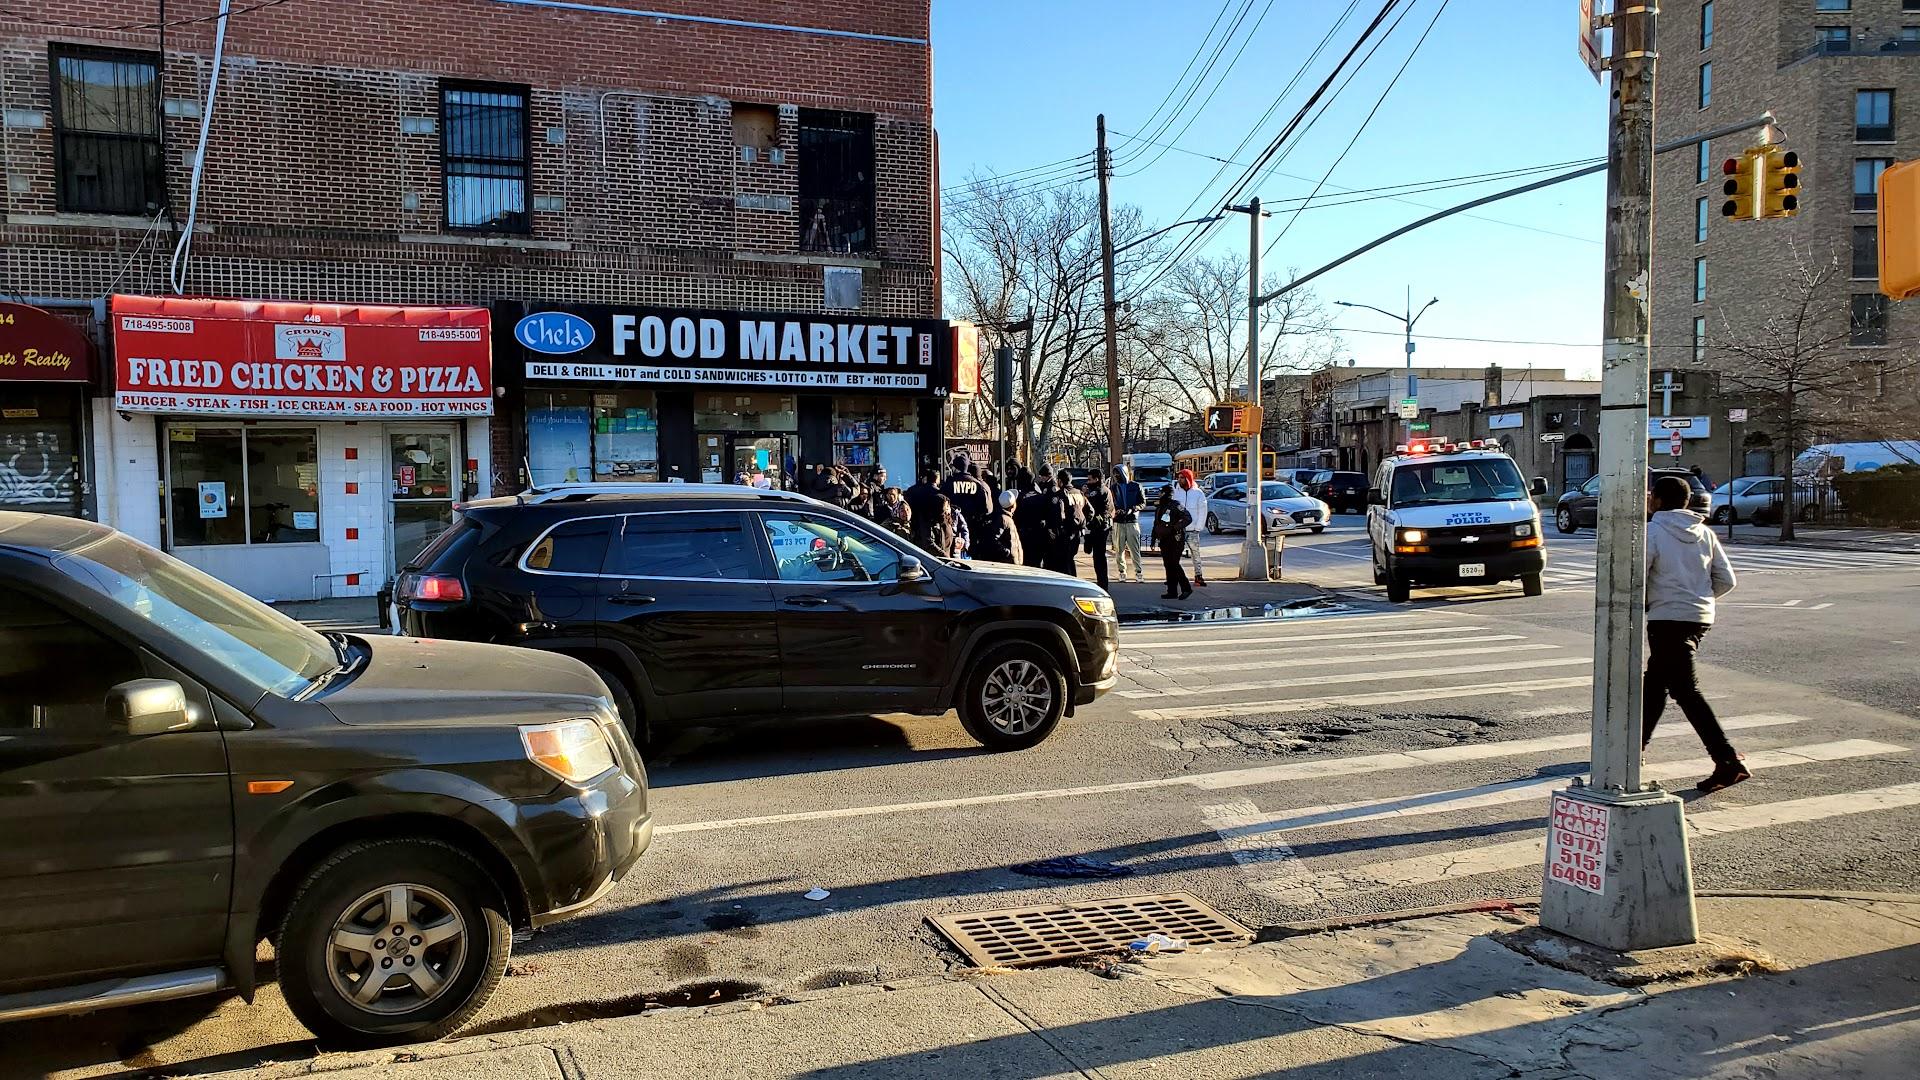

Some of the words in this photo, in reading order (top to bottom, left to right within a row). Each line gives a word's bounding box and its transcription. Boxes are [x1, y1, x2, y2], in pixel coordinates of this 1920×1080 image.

[124, 319, 192, 331] 718-495-5008
[285, 329, 331, 337] CROWN
[420, 329, 481, 340] 718-495-5001
[523, 317, 585, 347] Chela
[612, 314, 726, 359] FOOD
[739, 320, 913, 365] MARKET
[921, 335, 930, 364] CORP
[23, 348, 72, 371] Realty
[128, 357, 224, 388] FRIED
[230, 361, 365, 393] CHICKEN
[371, 365, 395, 393] &
[399, 365, 485, 393] PIZZA
[532, 365, 558, 377] DELI
[561, 366, 570, 377] &
[573, 366, 605, 378] GRILL
[614, 367, 637, 379] HOT
[640, 368, 660, 380] and
[663, 369, 692, 380] COLD
[694, 369, 767, 383] SANDWICHES
[774, 371, 808, 384] LOTTO
[816, 373, 839, 384] ATM
[846, 374, 865, 385] EBT
[873, 374, 892, 386] HOT
[894, 375, 920, 387] FOOD
[933, 386, 948, 397] 44
[121, 395, 177, 407] BURGER
[186, 398, 231, 409] STEAK
[239, 399, 269, 410] FISH
[278, 400, 299, 411] ICE
[301, 400, 346, 411] CREAM
[353, 401, 378, 412] SEA
[380, 401, 413, 412] FOOD
[421, 402, 445, 412] HOT
[445, 402, 488, 412] WINGS
[967, 444, 989, 453] DOLLAR
[953, 481, 978, 495] NYPD
[1446, 516, 1491, 526] POLICE
[784, 538, 793, 547] 73
[1555, 800, 1606, 823] CASH
[1556, 831, 1602, 856] (917)
[1560, 847, 1596, 872] 515
[1551, 862, 1602, 891] 6499
